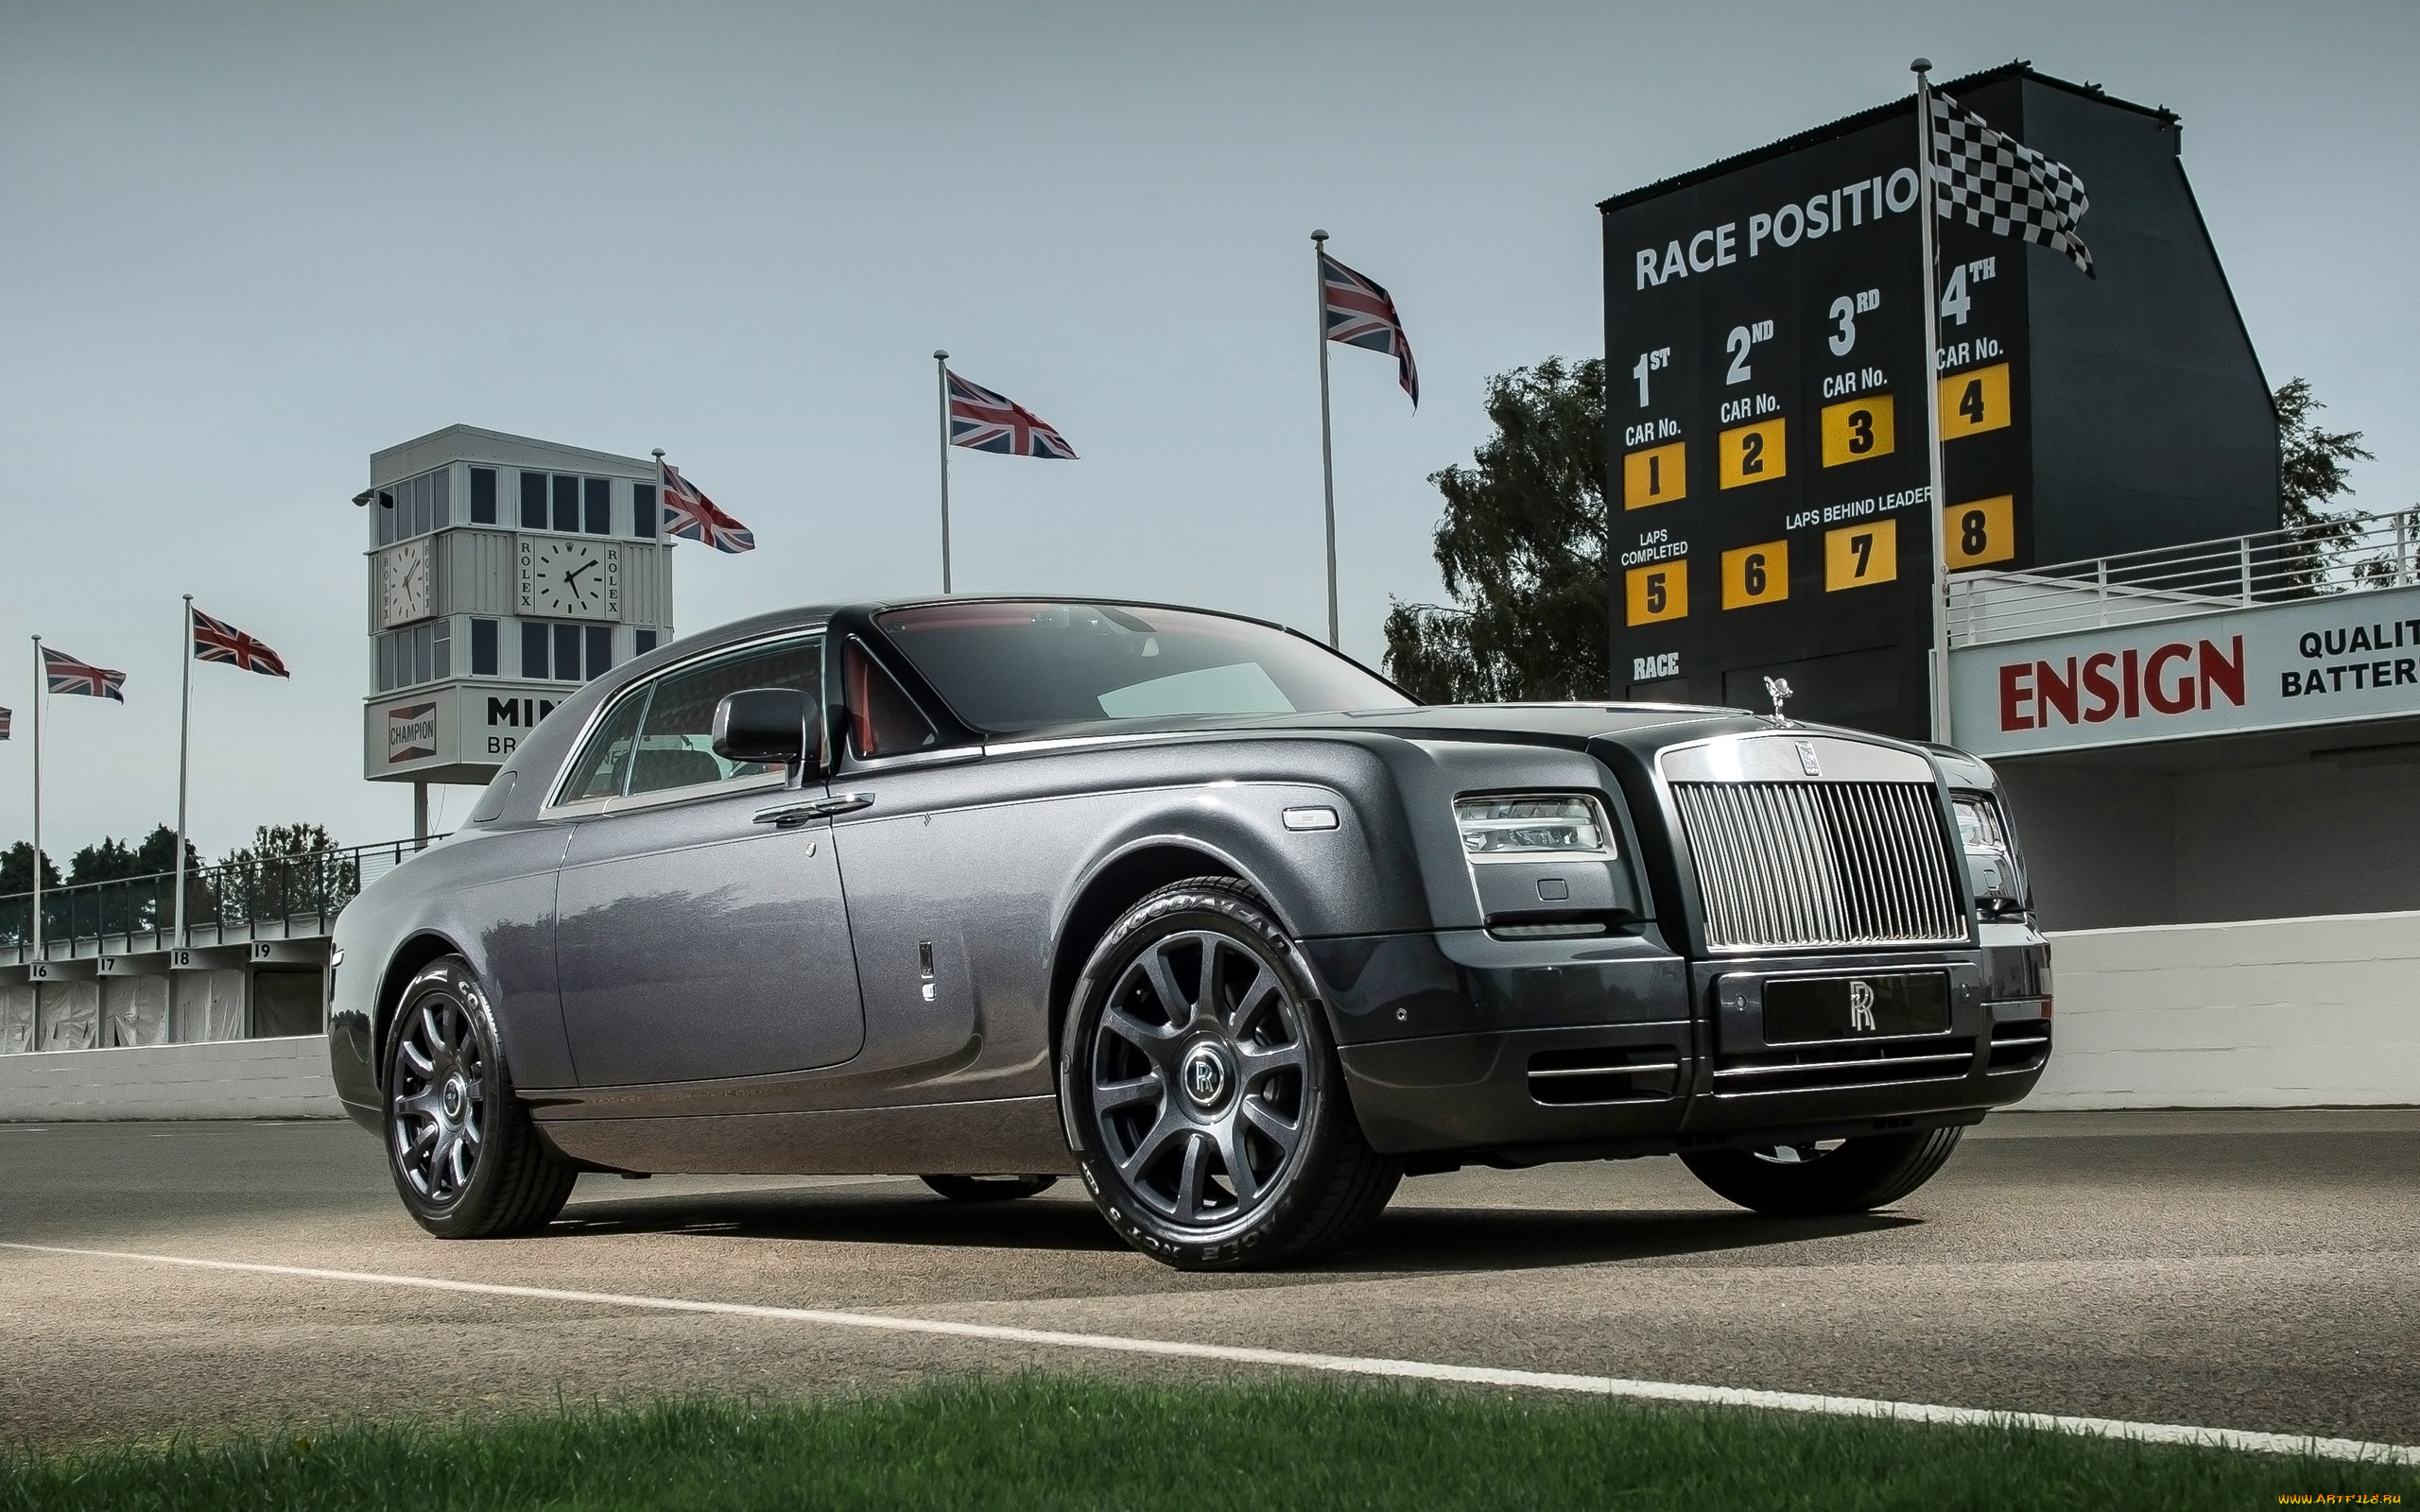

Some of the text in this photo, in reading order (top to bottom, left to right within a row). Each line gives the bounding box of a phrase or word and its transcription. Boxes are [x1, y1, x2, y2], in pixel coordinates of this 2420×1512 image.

[1635, 166, 1925, 291] RACE POSITIO
[1941, 256, 1996, 326] 4TH
[1828, 288, 1880, 356] 3RD
[1726, 319, 1774, 386] 2ND
[1936, 336, 2004, 369] CAR No.
[1633, 347, 1670, 407] 1ST
[1823, 367, 1888, 399] CAR No.
[1720, 393, 1781, 423] CAR No.
[1959, 378, 1984, 424] 4
[1625, 418, 1682, 447] CAR No.
[1848, 409, 1875, 455] 3
[1741, 432, 1764, 476] 2
[1786, 509, 1820, 530] LAPS
[1824, 498, 1876, 523] BEHIND
[1961, 509, 1987, 556] 8
[1620, 541, 1688, 566] COMPLETED
[1639, 528, 1668, 547] LAPS
[1850, 533, 1874, 578] 7
[521, 542, 531, 606] ROLEX
[608, 549, 618, 612] ROLEX
[1647, 572, 1667, 614] 5
[1744, 554, 1767, 596] 6
[2299, 618, 2420, 660] QUALIT
[1634, 652, 1679, 680] RACE
[1999, 634, 2246, 732] ENSIGN
[390, 719, 434, 746] CHAMPION
[32, 965, 47, 978] 16
[100, 958, 114, 971] 17
[175, 952, 189, 965] 18
[254, 944, 270, 958] 19
